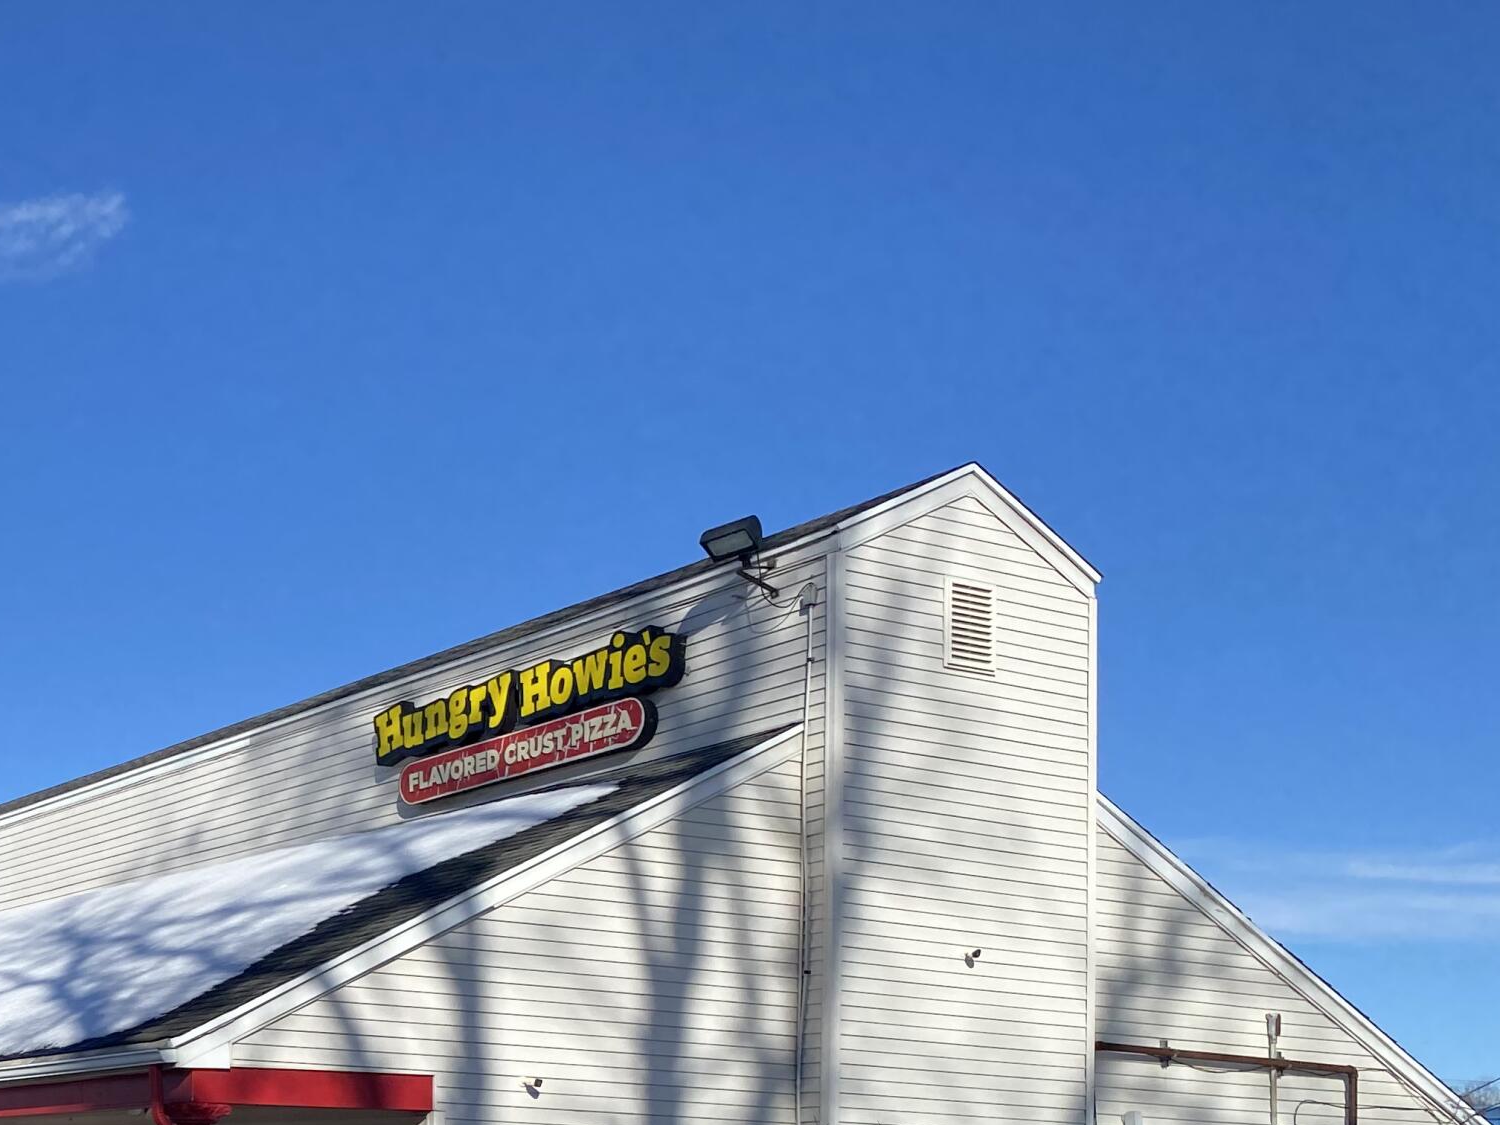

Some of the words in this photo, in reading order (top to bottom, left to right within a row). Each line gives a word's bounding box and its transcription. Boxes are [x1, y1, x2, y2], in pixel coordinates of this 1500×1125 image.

[375, 672, 512, 758] Hungry
[519, 630, 672, 718] Howie's
[408, 748, 500, 793] FLAVORED
[504, 726, 566, 766] CRUST
[570, 709, 633, 749] PIZZA
